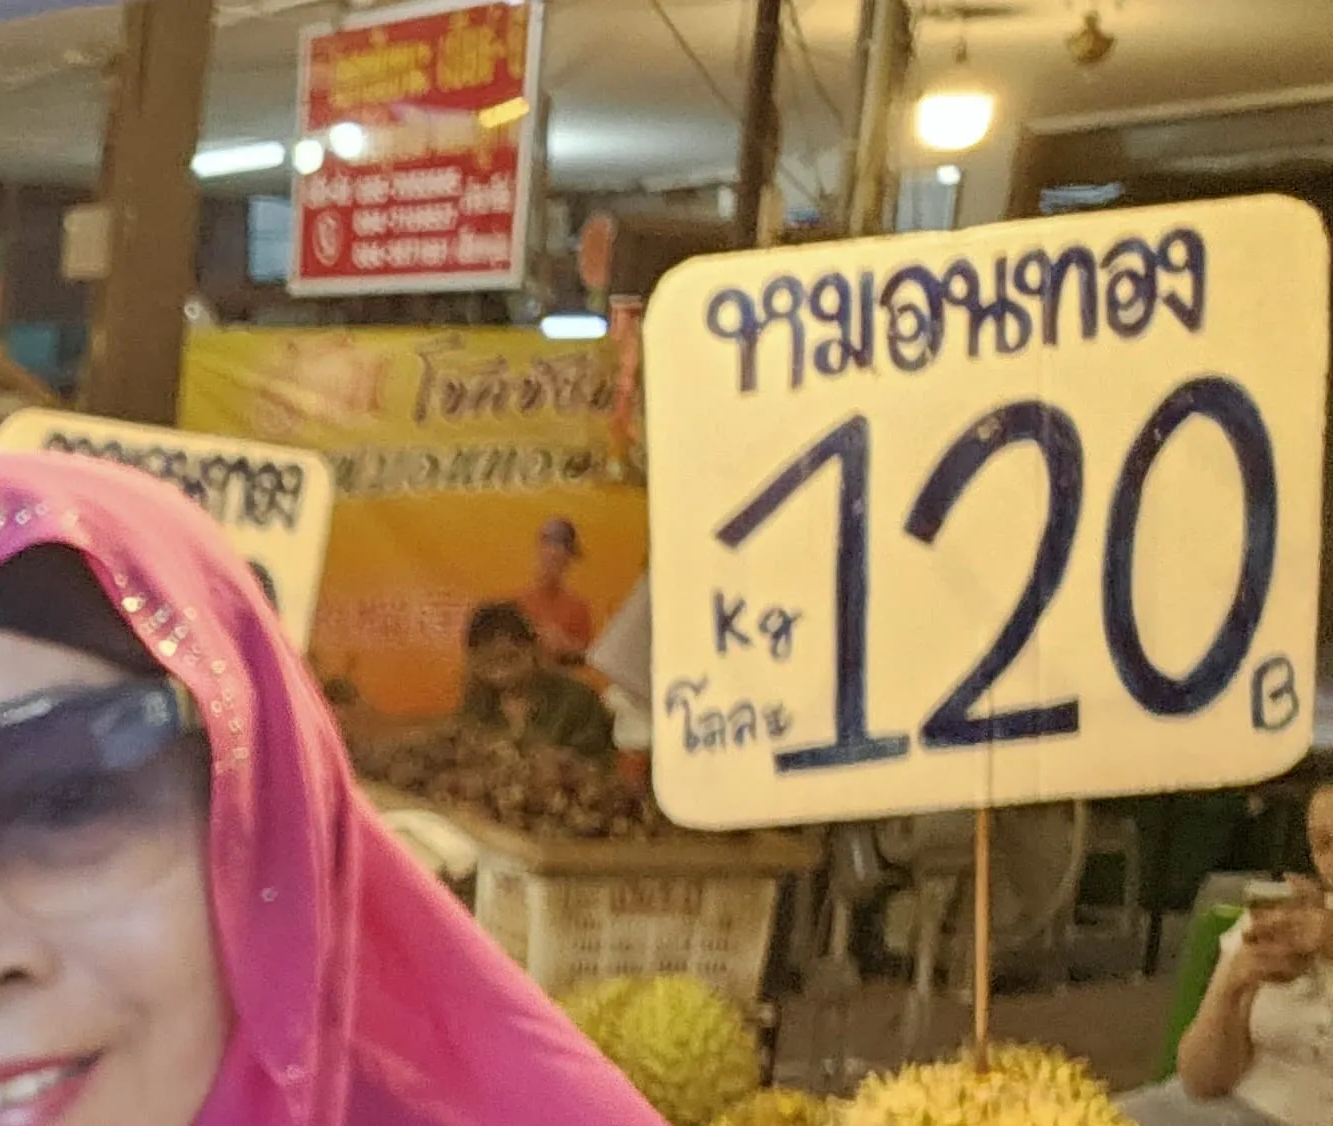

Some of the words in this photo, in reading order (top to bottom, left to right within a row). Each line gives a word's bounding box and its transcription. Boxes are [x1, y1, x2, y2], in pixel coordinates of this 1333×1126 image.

[706, 228, 1206, 394] หมอนทอง
[714, 374, 1278, 774] 120
